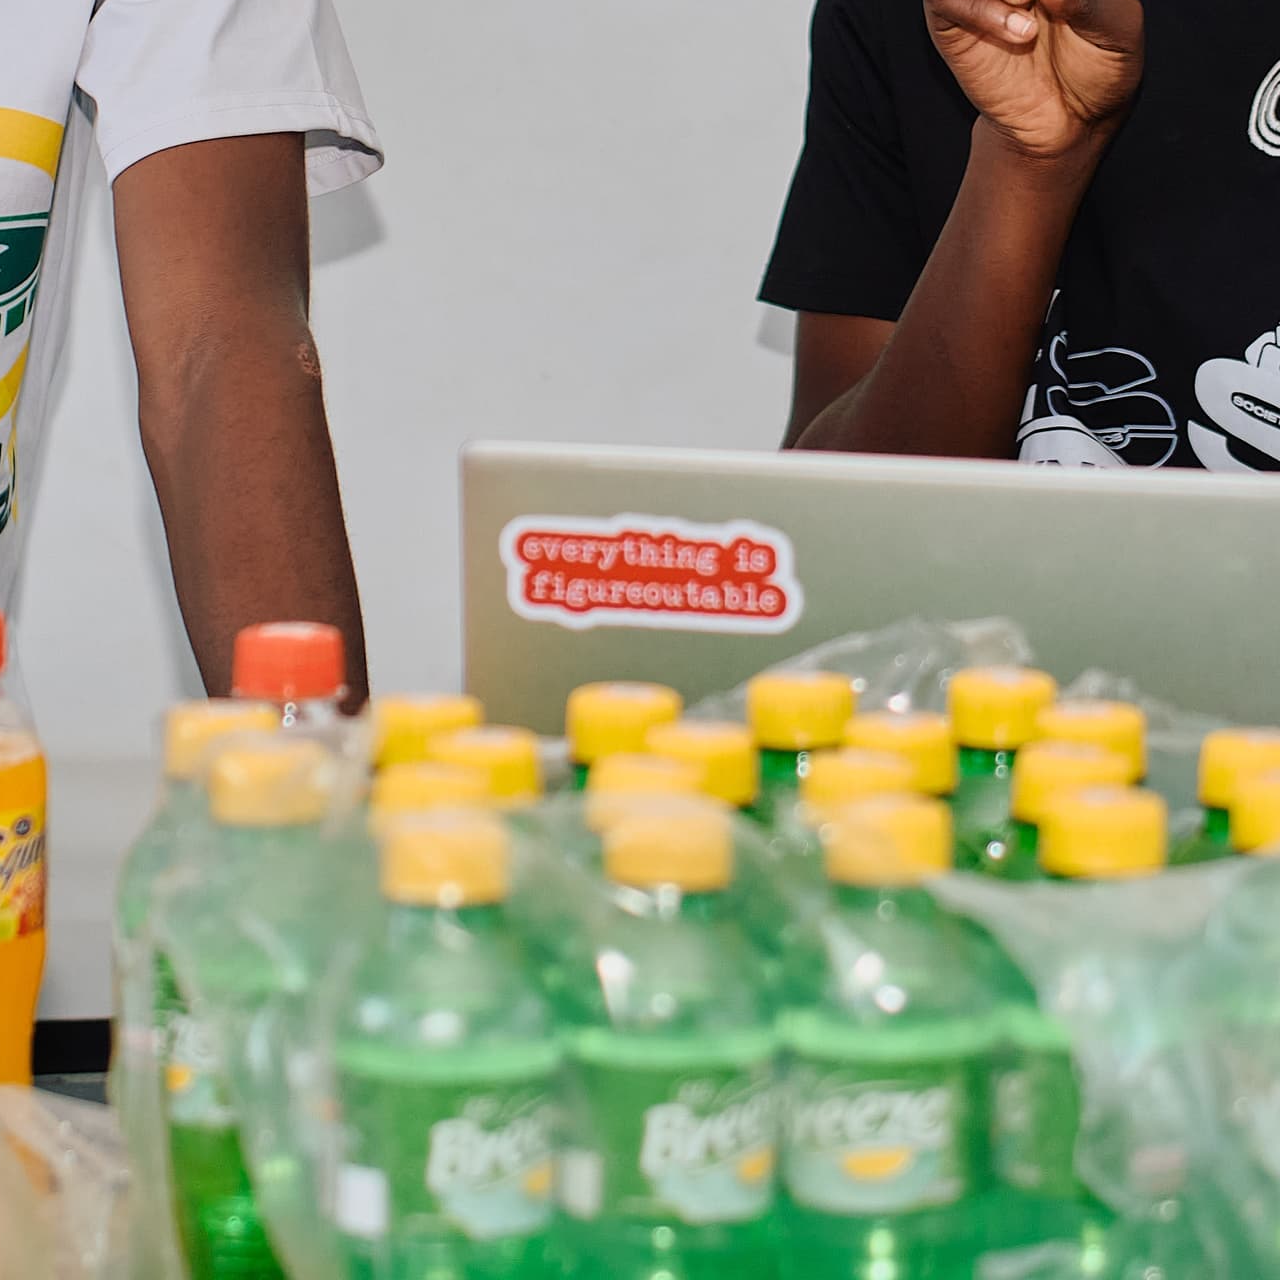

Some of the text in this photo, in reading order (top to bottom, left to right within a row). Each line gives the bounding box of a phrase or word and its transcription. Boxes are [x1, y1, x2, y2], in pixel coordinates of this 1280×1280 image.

[522, 536, 770, 576] everything is
[531, 570, 780, 613] figureoutable
